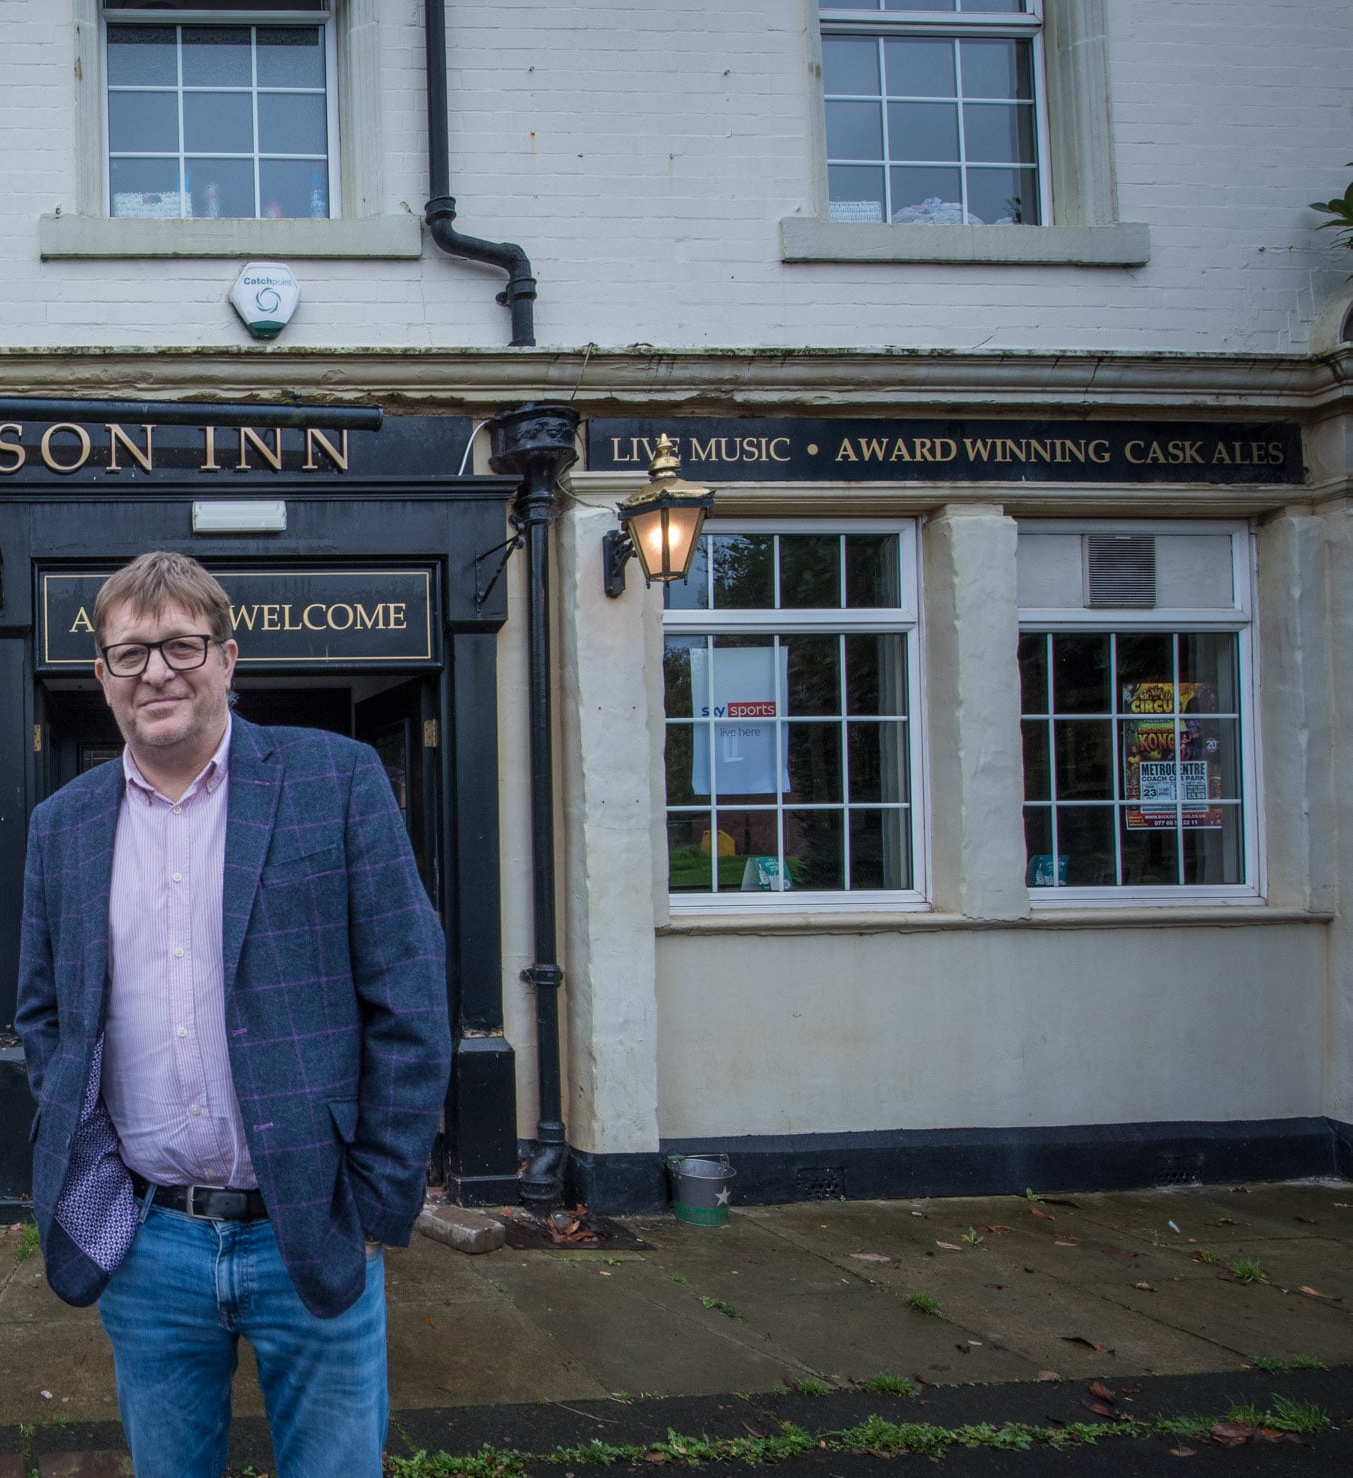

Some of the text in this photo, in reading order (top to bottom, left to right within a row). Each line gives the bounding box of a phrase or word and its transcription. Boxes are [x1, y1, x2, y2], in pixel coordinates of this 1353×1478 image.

[244, 277, 292, 286] Catchpoint
[203, 425, 348, 472] INN
[688, 437, 791, 462] MUSIC
[834, 437, 957, 463] AWARD
[962, 438, 1113, 463] WINNING
[1124, 440, 1205, 464] CASK
[1210, 441, 1286, 465] ALES
[68, 602, 408, 633] A WELCOME
[730, 704, 775, 718] sports
[1131, 700, 1182, 713] CIRCU
[720, 728, 761, 736] live here
